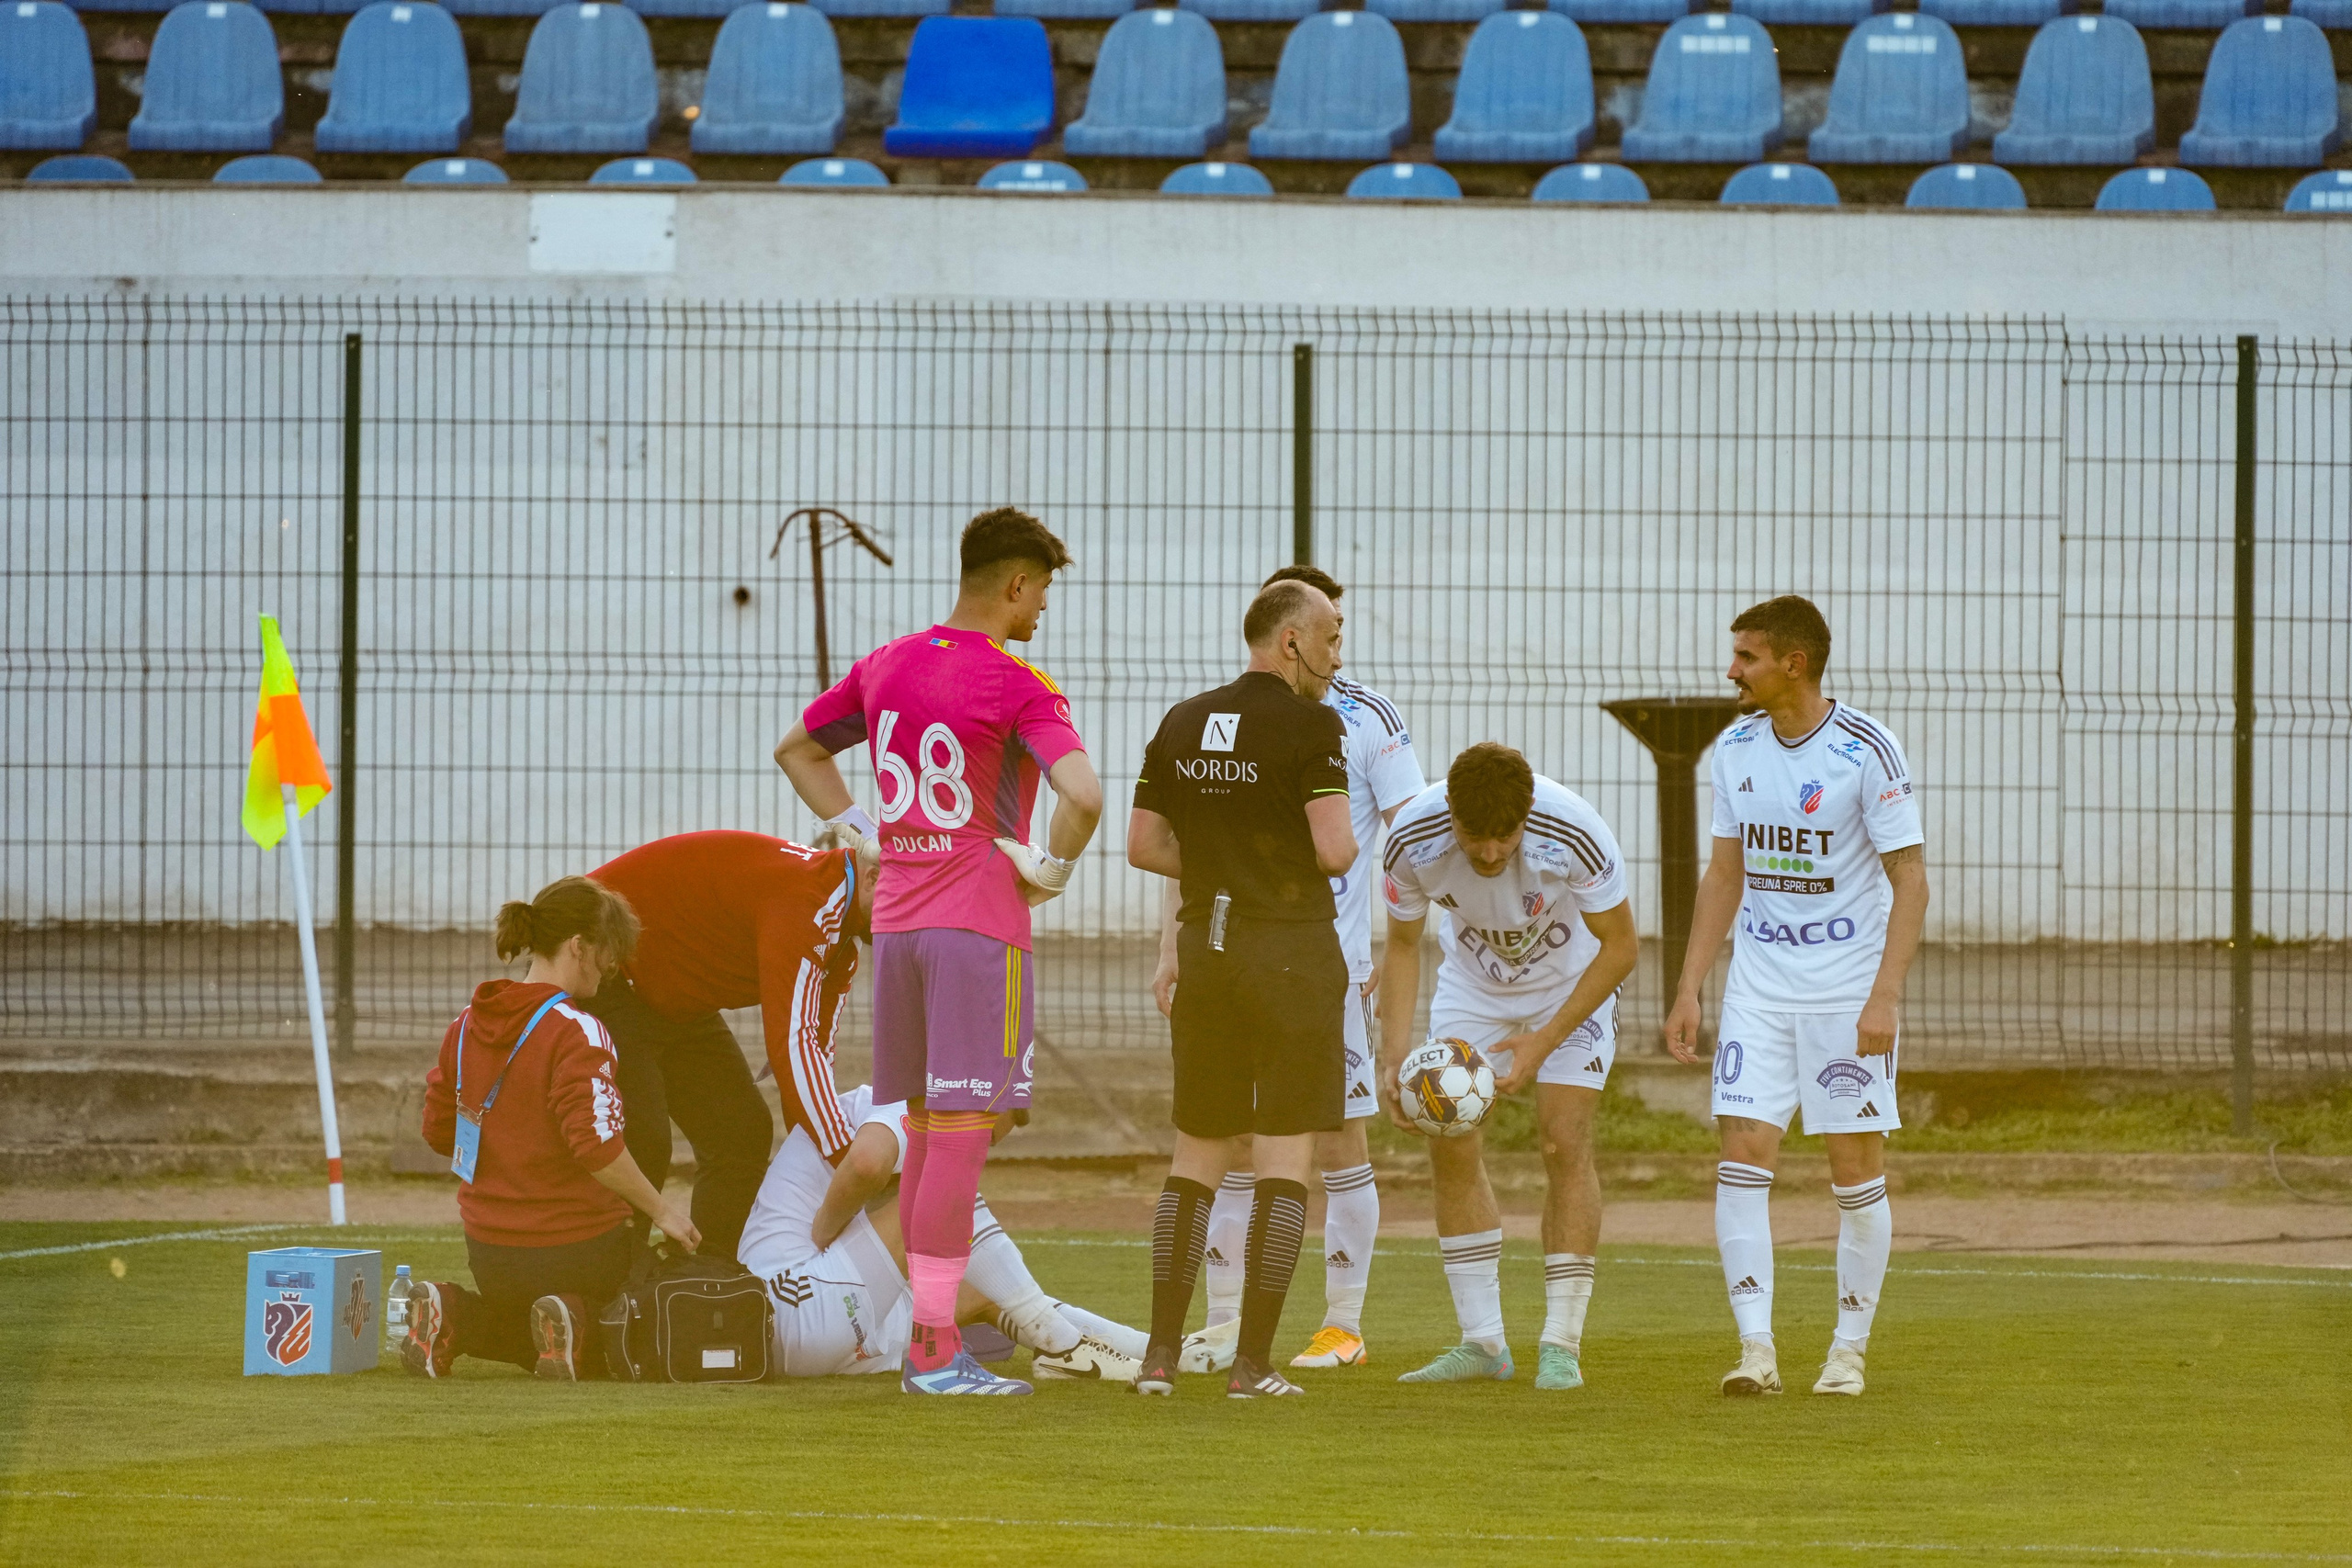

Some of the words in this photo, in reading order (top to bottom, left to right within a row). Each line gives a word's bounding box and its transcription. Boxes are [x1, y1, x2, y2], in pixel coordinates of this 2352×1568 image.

[876, 709, 974, 829] 68
[1175, 758, 1259, 784] NORDIS
[1879, 788, 1901, 802] ABC
[891, 833, 953, 853] DUCAN
[1782, 881, 1808, 893] SPRE
[1809, 882, 1827, 894] 0%
[1401, 1049, 1445, 1078] SELECT
[1819, 1070, 1832, 1085] FIVE
[1830, 1066, 1870, 1083] CONTINENTS
[933, 1077, 968, 1089] Smart
[969, 1078, 993, 1089] Eco
[972, 1089, 992, 1098] Plus
[1721, 1091, 1754, 1104] Vestra
[1731, 1287, 1765, 1296] adidas
